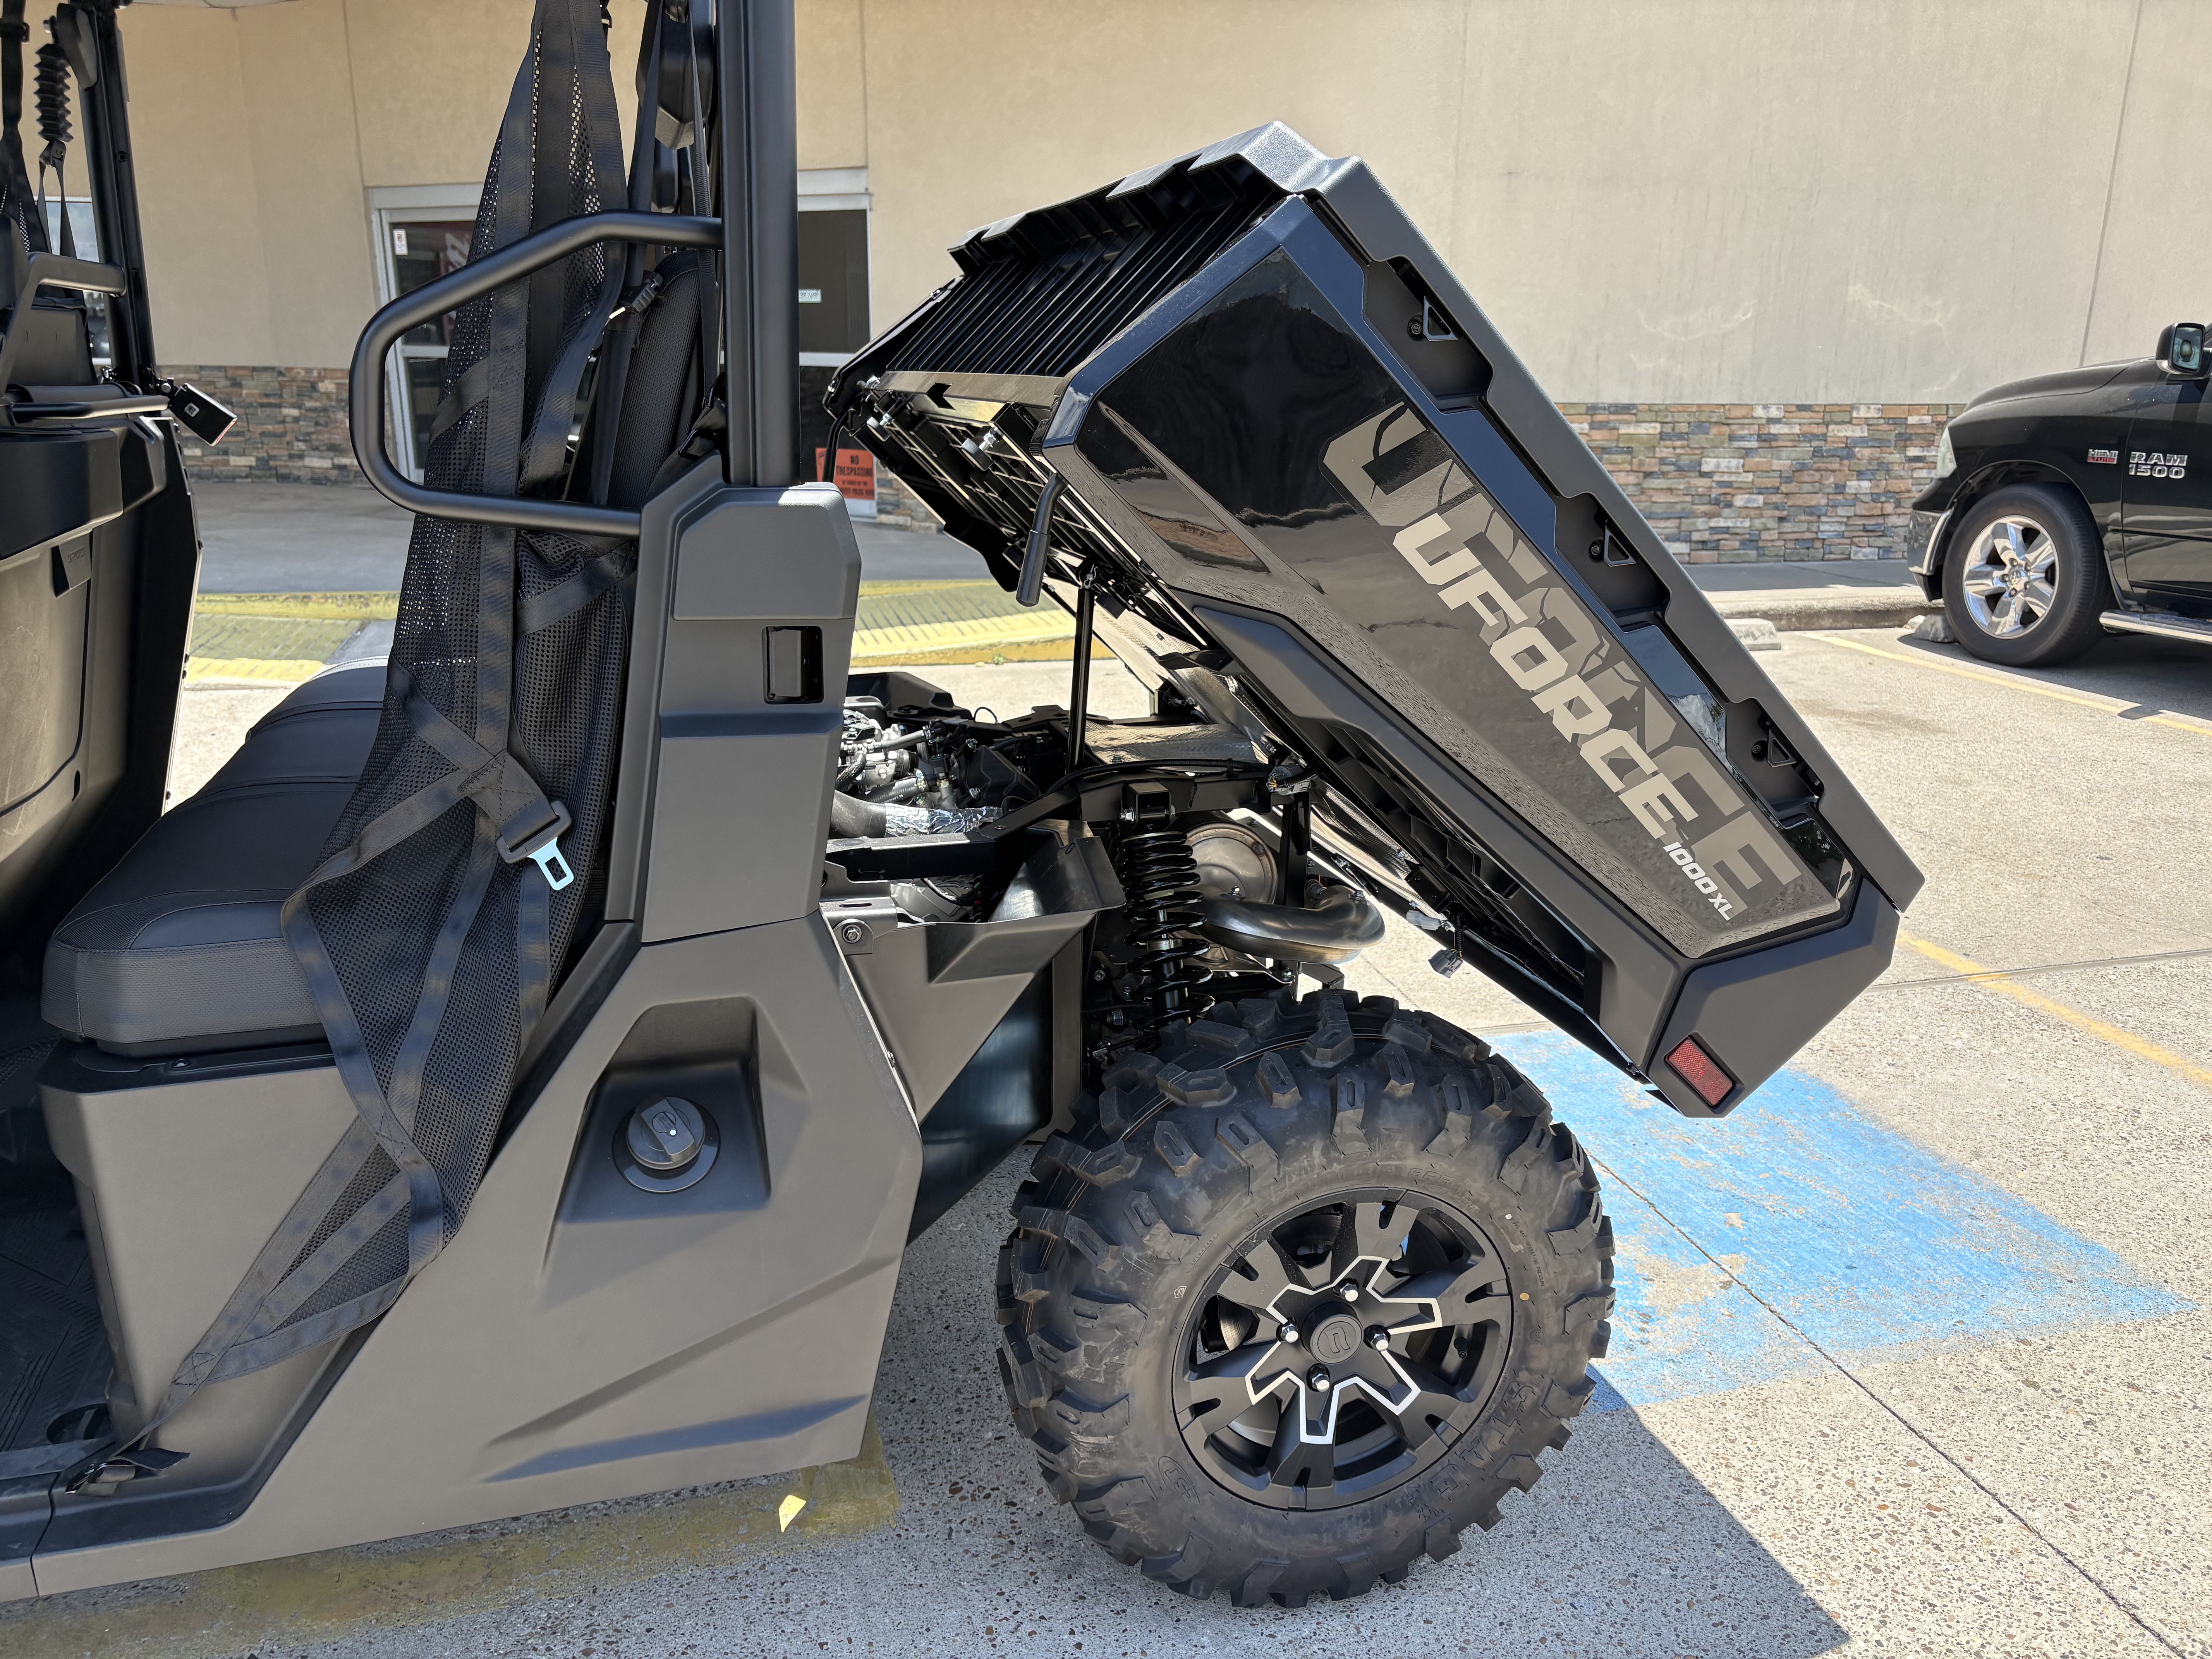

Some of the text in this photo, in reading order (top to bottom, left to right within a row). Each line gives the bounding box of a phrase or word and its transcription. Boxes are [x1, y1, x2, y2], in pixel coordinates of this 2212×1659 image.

[850, 455, 859, 465] NO
[2130, 452, 2188, 466] RAM
[2129, 464, 2185, 479] 1500
[1393, 512, 1698, 839] UFORCE
